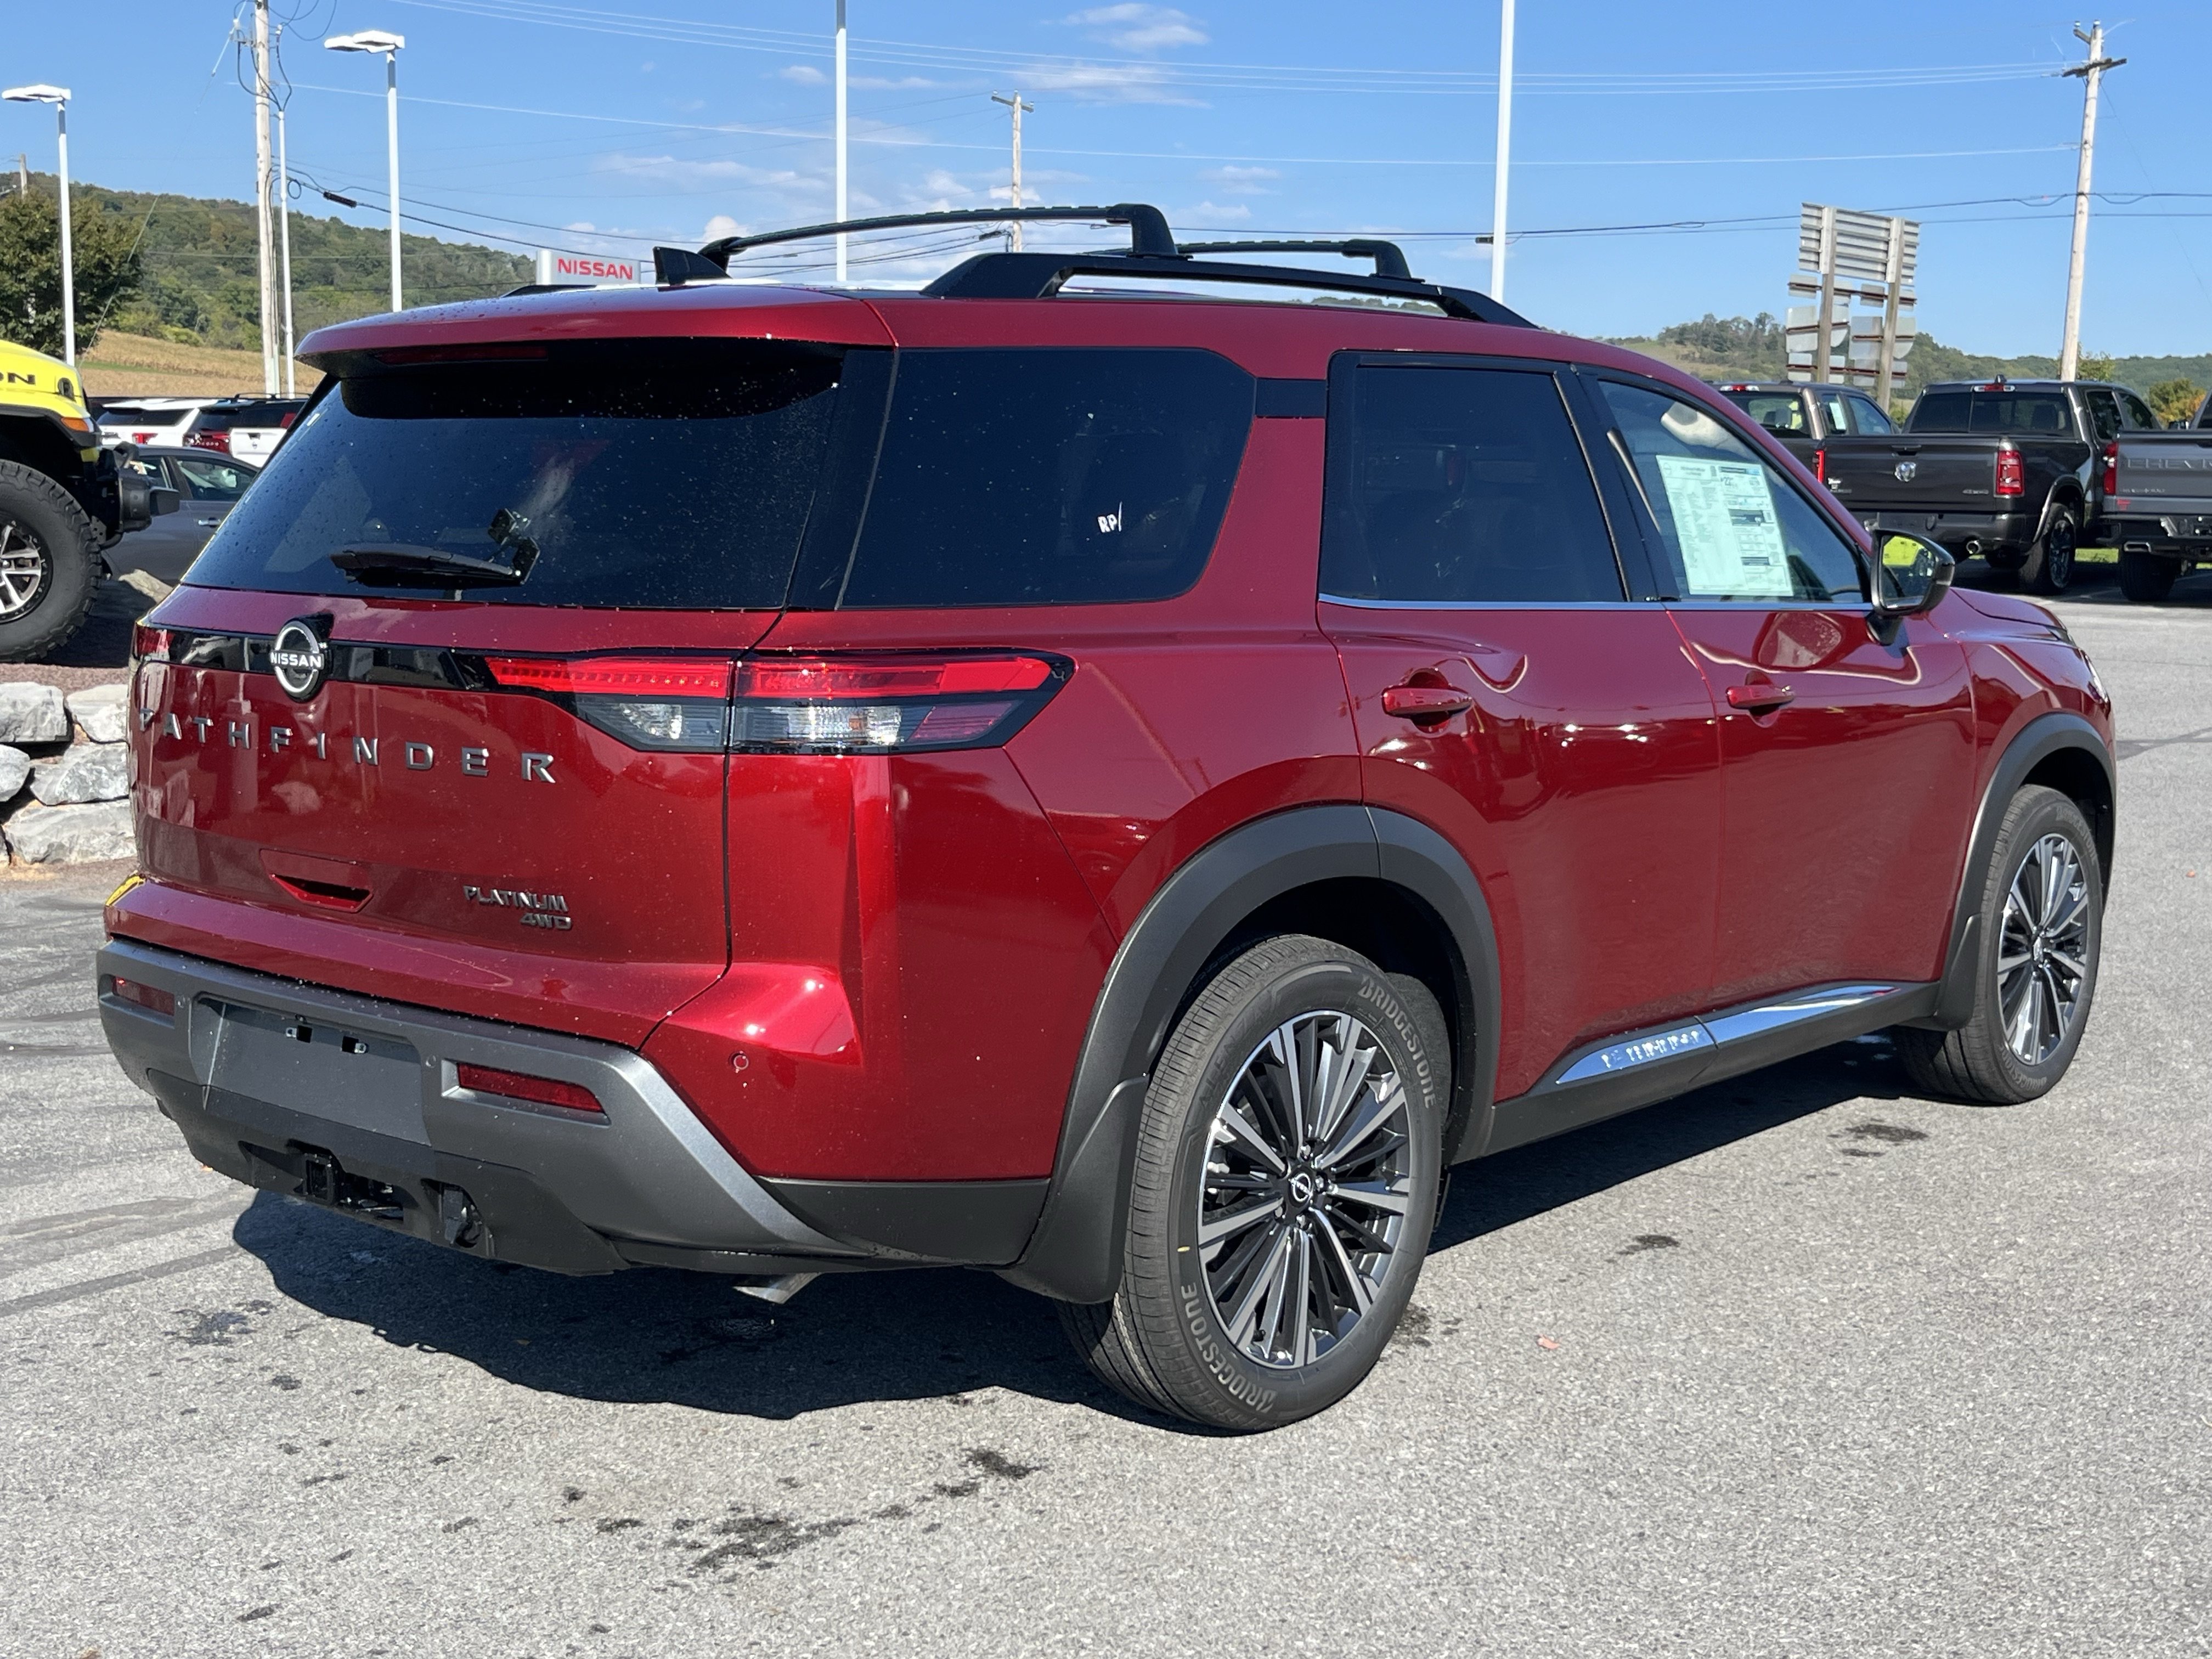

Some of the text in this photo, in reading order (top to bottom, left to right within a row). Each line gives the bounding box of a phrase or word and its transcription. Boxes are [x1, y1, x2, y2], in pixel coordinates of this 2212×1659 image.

[557, 258, 632, 280] NISSAN
[270, 653, 322, 668] NISSAN
[139, 708, 556, 783] PATHFINDER
[463, 885, 569, 912] PLATINUM
[520, 912, 572, 930] 4WD
[1358, 974, 1437, 1109] BRIDGESTONE
[1181, 1282, 1277, 1413] BRIDGESTONE
